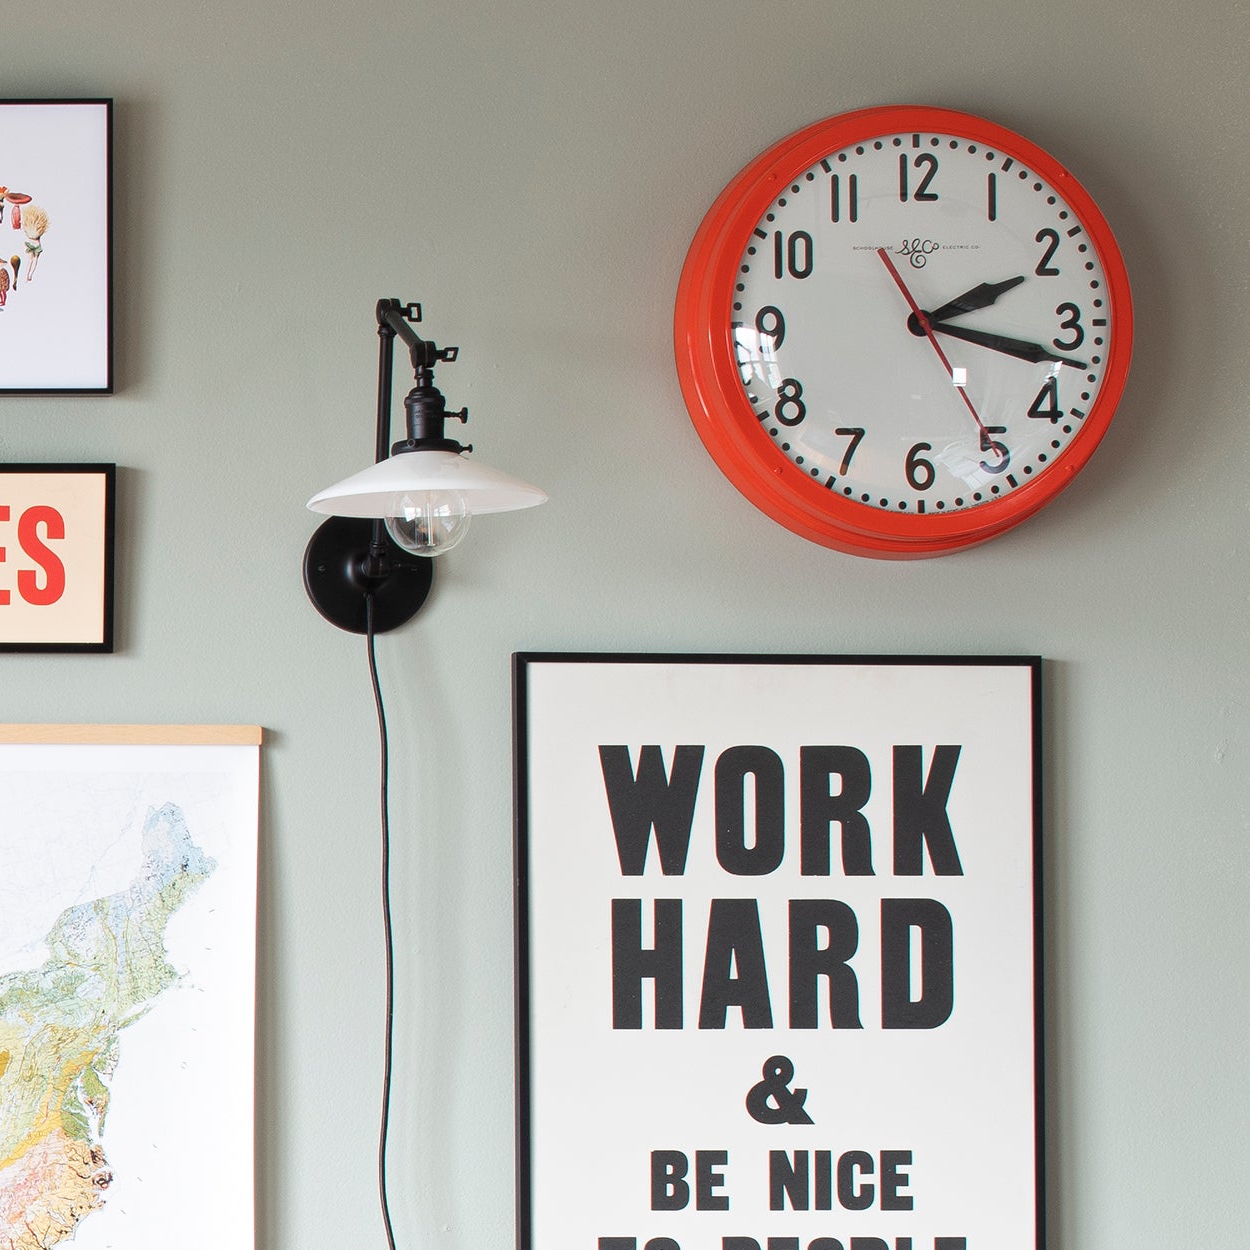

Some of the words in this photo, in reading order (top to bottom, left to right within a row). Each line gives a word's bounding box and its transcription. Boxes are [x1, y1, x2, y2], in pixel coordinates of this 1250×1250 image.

[831, 173, 858, 223] 11
[899, 153, 939, 202] 12
[987, 172, 997, 221] 1
[775, 230, 814, 279] 10
[1034, 228, 1060, 276] 2
[755, 305, 786, 353] 9
[1052, 302, 1085, 351] 3
[774, 378, 806, 427] 8
[1027, 376, 1064, 424] 4
[835, 427, 865, 476] 7
[905, 442, 936, 491] 6
[979, 426, 1010, 474] 5
[598, 744, 964, 877] WORK
[611, 898, 954, 1030] HARD
[745, 1055, 815, 1125] &
[651, 1150, 730, 1211] BE
[769, 1150, 914, 1211] NICE
